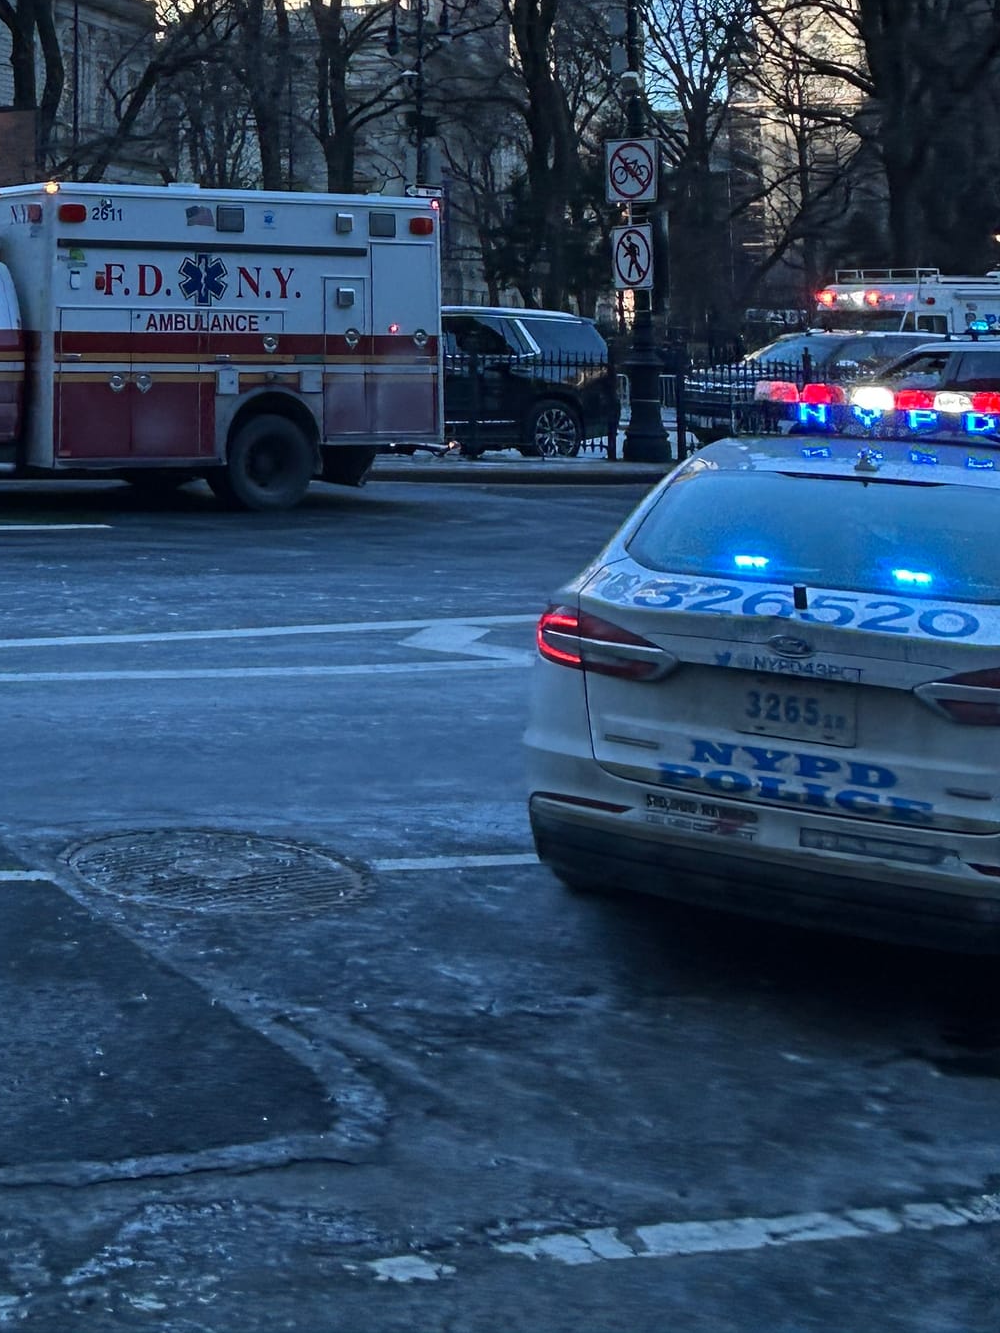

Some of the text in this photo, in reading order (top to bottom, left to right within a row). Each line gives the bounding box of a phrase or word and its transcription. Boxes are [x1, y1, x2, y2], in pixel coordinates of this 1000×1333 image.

[92, 207, 122, 222] 2611
[103, 263, 302, 299] F.D. N.Y.
[145, 313, 260, 332] AMBULANCE
[633, 581, 980, 638] 326520
[746, 691, 819, 726] 3265
[690, 740, 897, 789] NYPD
[658, 763, 934, 823] POLICE
